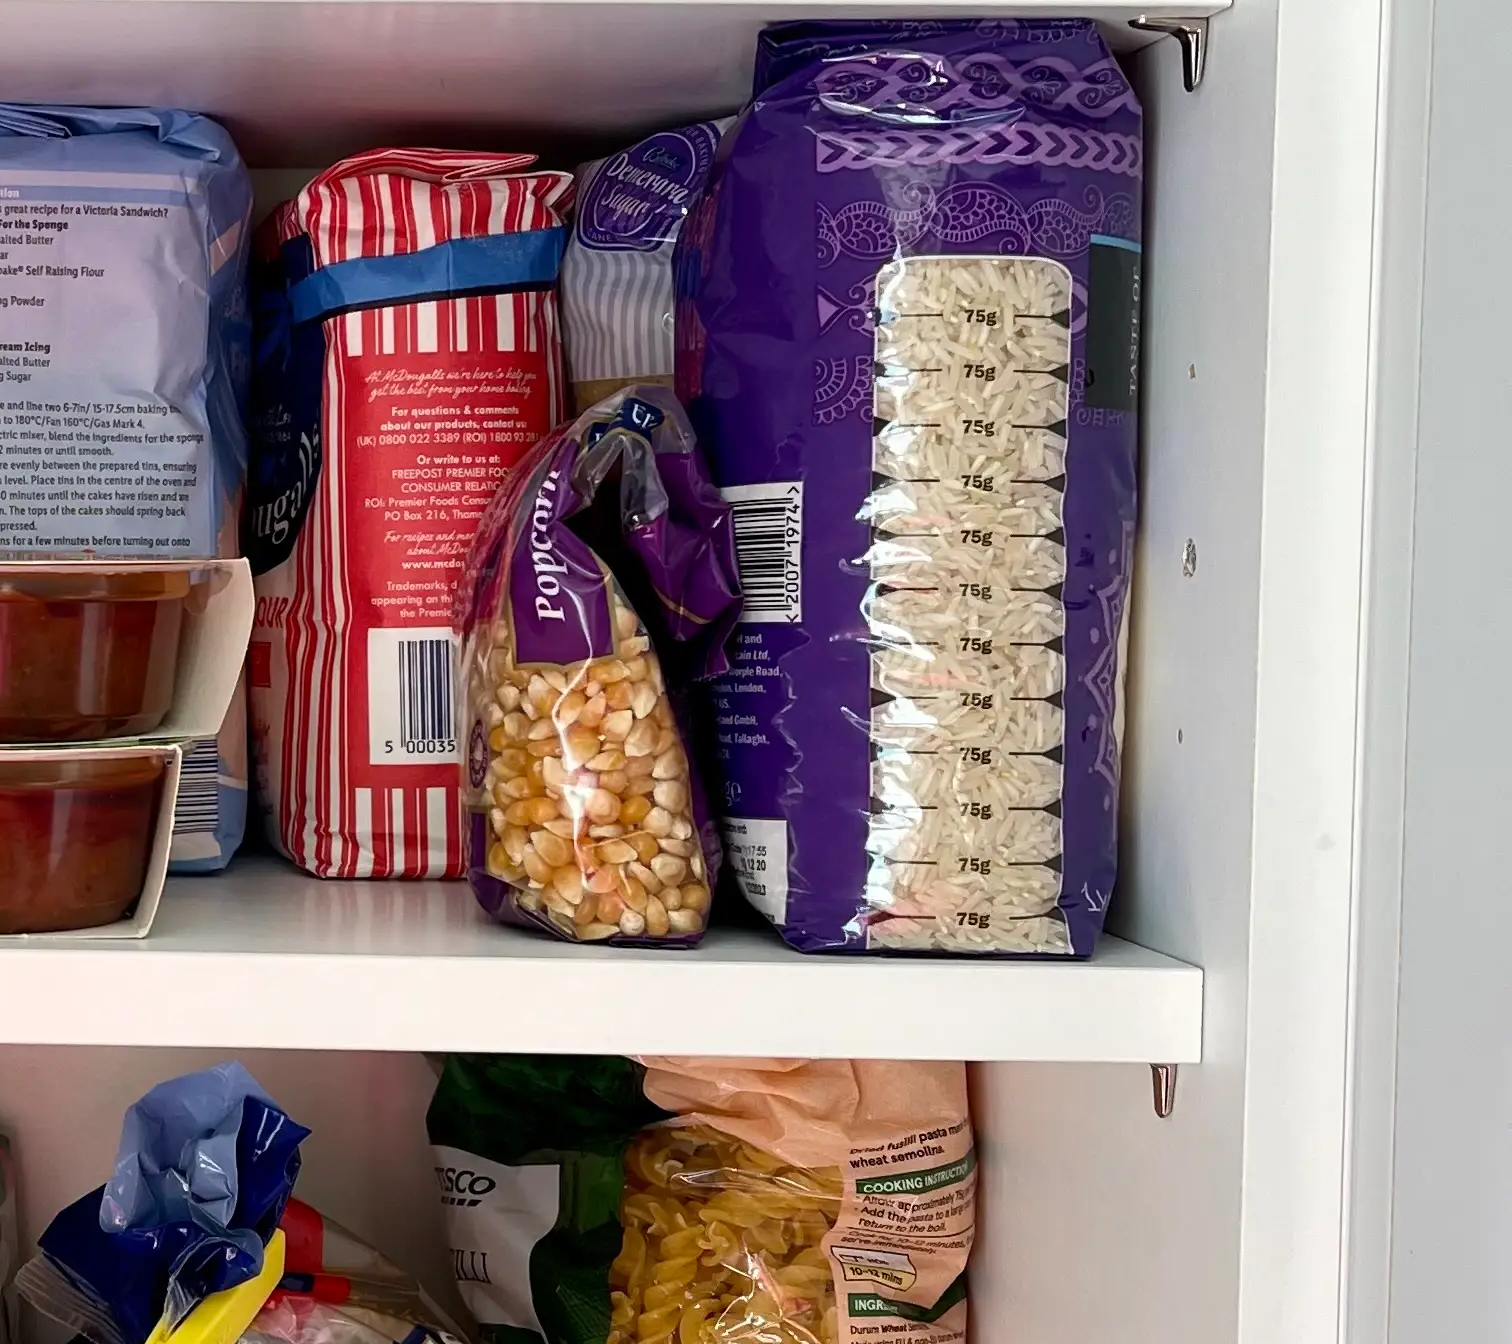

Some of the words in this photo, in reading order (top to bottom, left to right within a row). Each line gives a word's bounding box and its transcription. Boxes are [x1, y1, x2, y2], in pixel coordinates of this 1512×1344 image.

[607, 153, 688, 205] Demerara
[602, 183, 651, 221] Sugar
[4, 205, 28, 216] great
[30, 205, 58, 217] recipe
[61, 205, 73, 215] for
[83, 205, 118, 217] Victoria
[120, 206, 168, 219] Sandwich?
[14, 220, 30, 230] the
[32, 220, 69, 232] Sponge
[26, 235, 54, 246] Butter
[10, 296, 45, 307] Powder
[964, 308, 997, 327] 75g
[963, 363, 996, 383] 75g
[391, 407, 408, 416] For
[411, 407, 462, 418] questions
[464, 406, 471, 415] &
[474, 406, 519, 415] comments
[962, 419, 995, 437] 75g
[357, 434, 376, 448] (UK)
[379, 433, 406, 445] 0800
[409, 433, 430, 444] 022
[433, 433, 460, 443] 3389
[417, 456, 430, 465] Or
[434, 455, 459, 464] write
[462, 455, 472, 464] to
[475, 455, 486, 464] us
[392, 469, 442, 479] FREEPOST
[446, 468, 486, 478] PREMIER
[961, 473, 994, 492] 75g
[401, 482, 462, 493] CONSUMER
[785, 503, 800, 540] 1974
[531, 470, 569, 622] Popcorn
[960, 529, 993, 548] 75g
[784, 564, 800, 606] 2007
[959, 582, 992, 601] 75g
[959, 636, 992, 655] 75g
[959, 692, 993, 711] 75g
[385, 740, 393, 754] 5
[959, 746, 992, 765] 75g
[959, 801, 992, 820] 75g
[958, 856, 991, 874] 75g
[956, 910, 989, 929] 75g
[850, 1154, 889, 1169] wheat
[863, 1177, 924, 1194] COOKING
